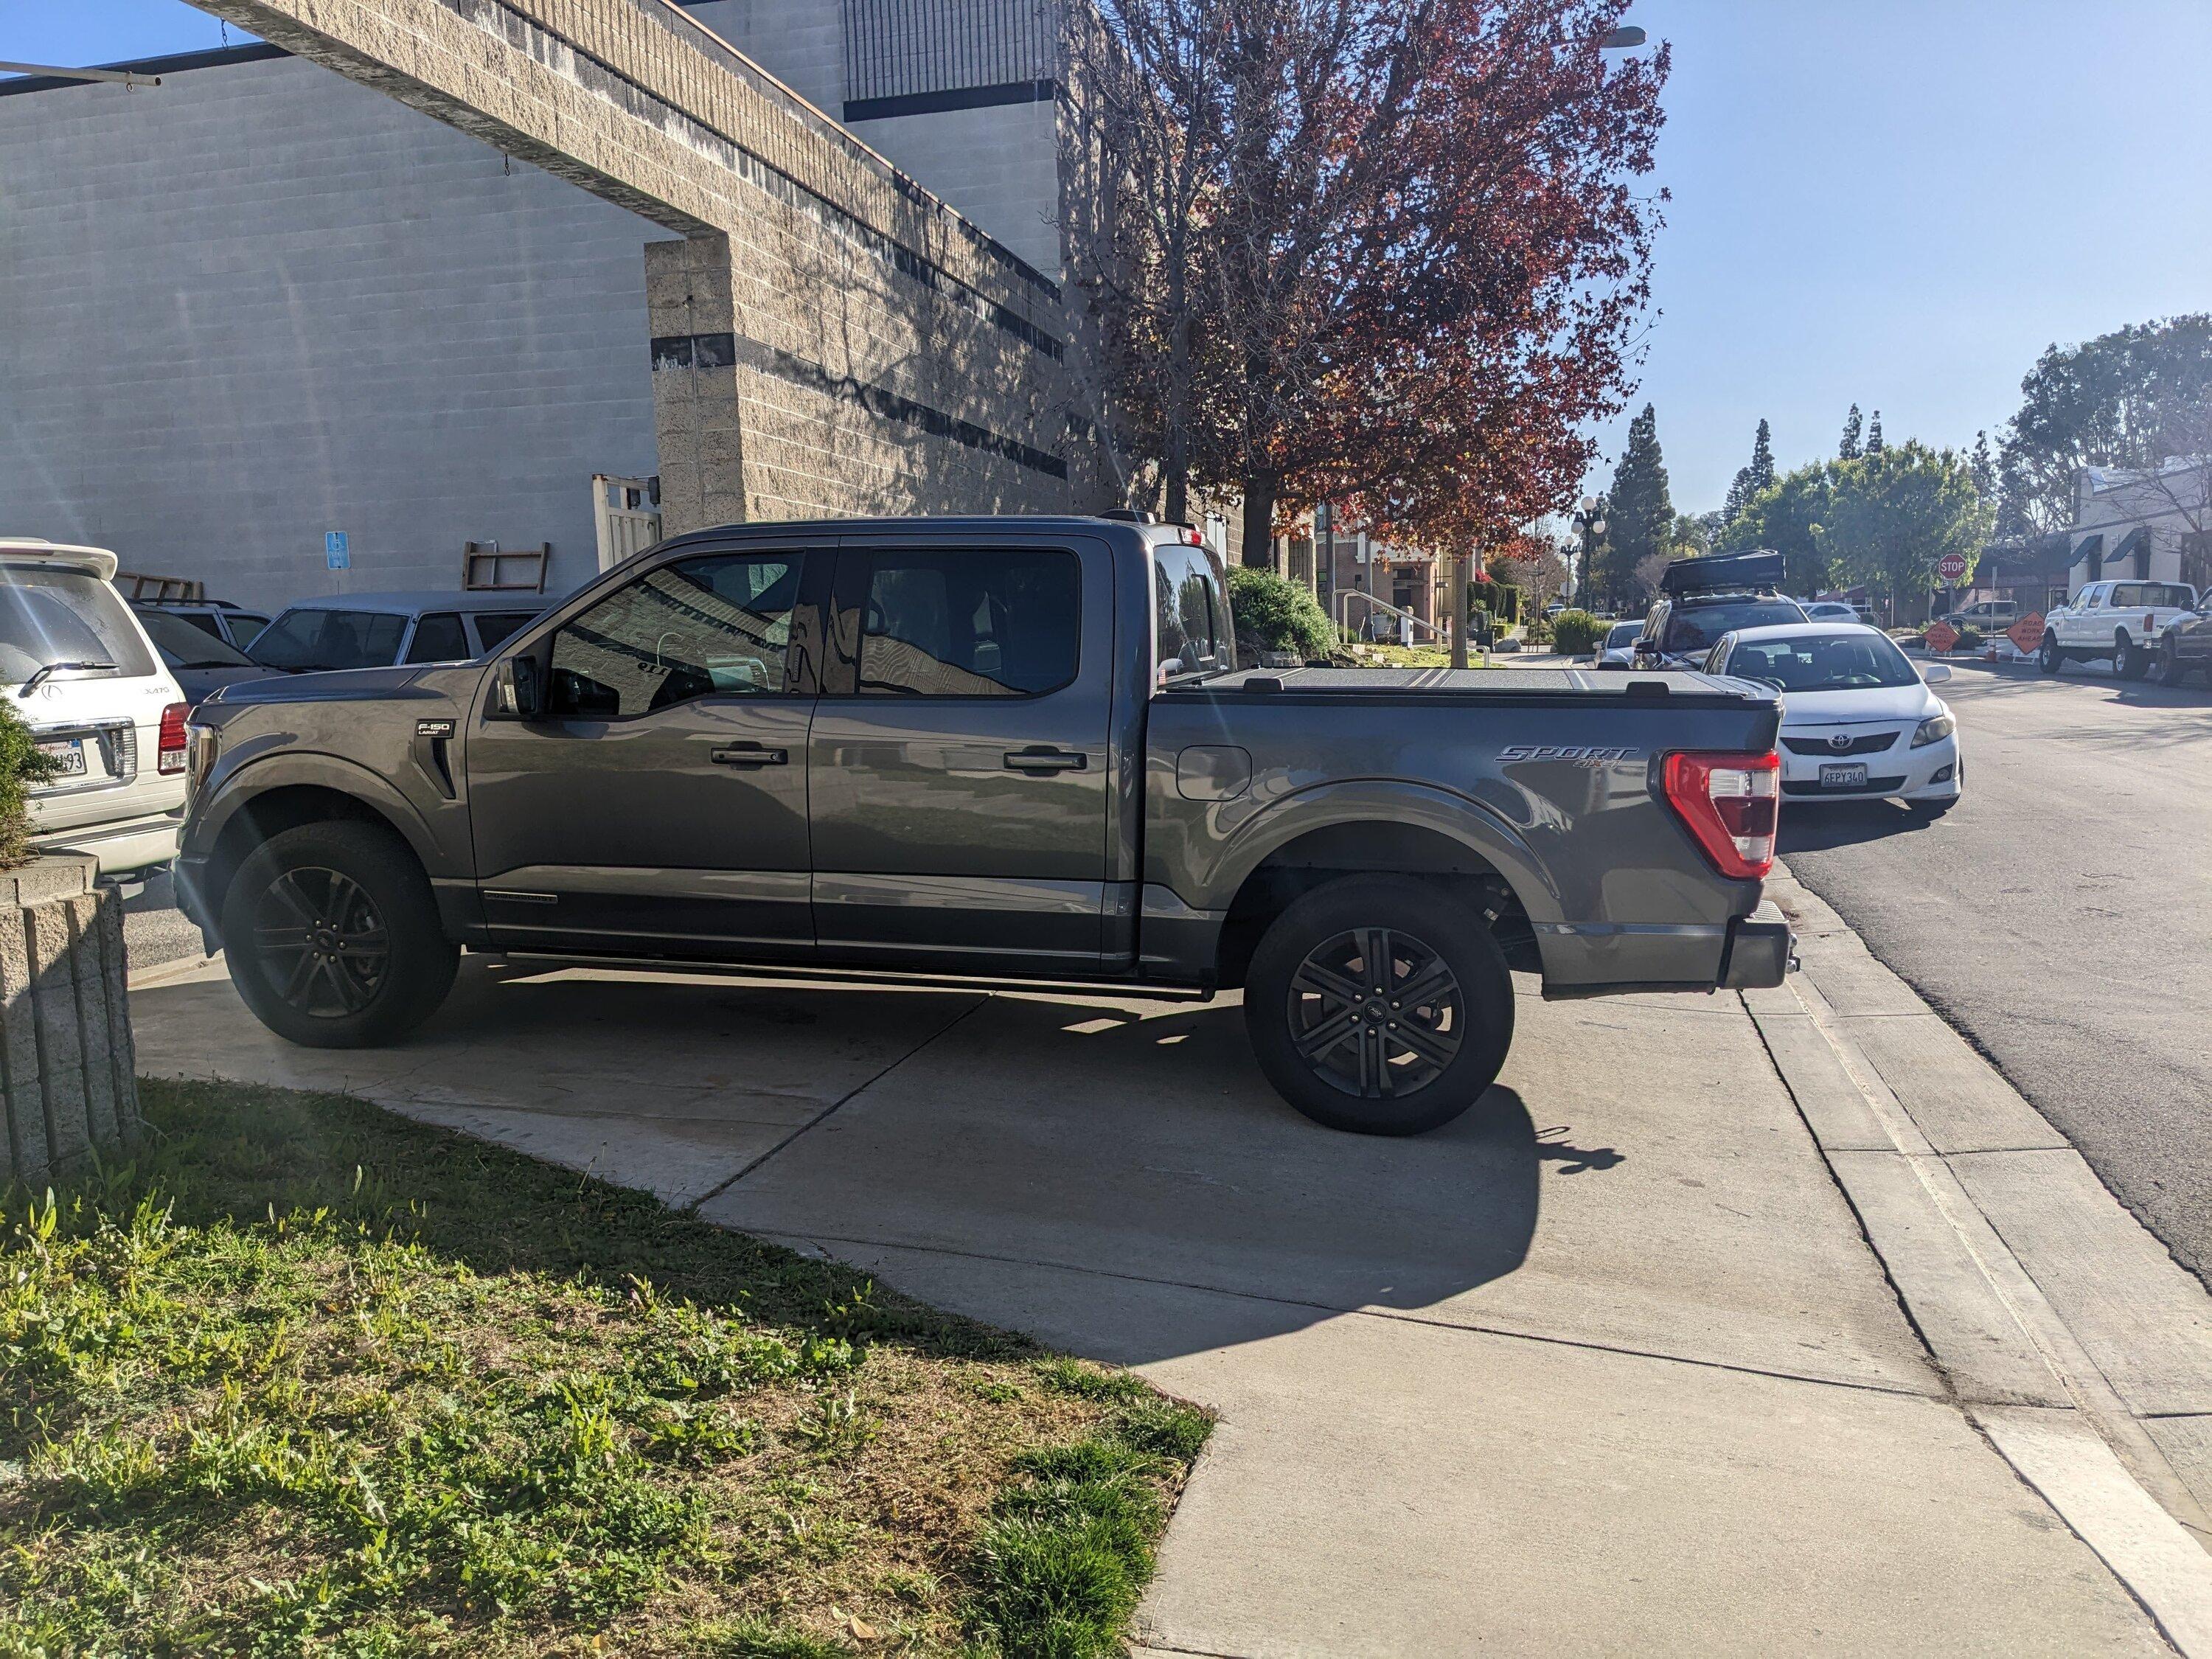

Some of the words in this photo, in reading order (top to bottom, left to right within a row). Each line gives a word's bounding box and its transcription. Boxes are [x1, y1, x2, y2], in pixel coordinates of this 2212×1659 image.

[1941, 562, 1964, 571] STOP
[1494, 745, 1640, 763] SPORT
[1824, 771, 1864, 783] 6EPY340
